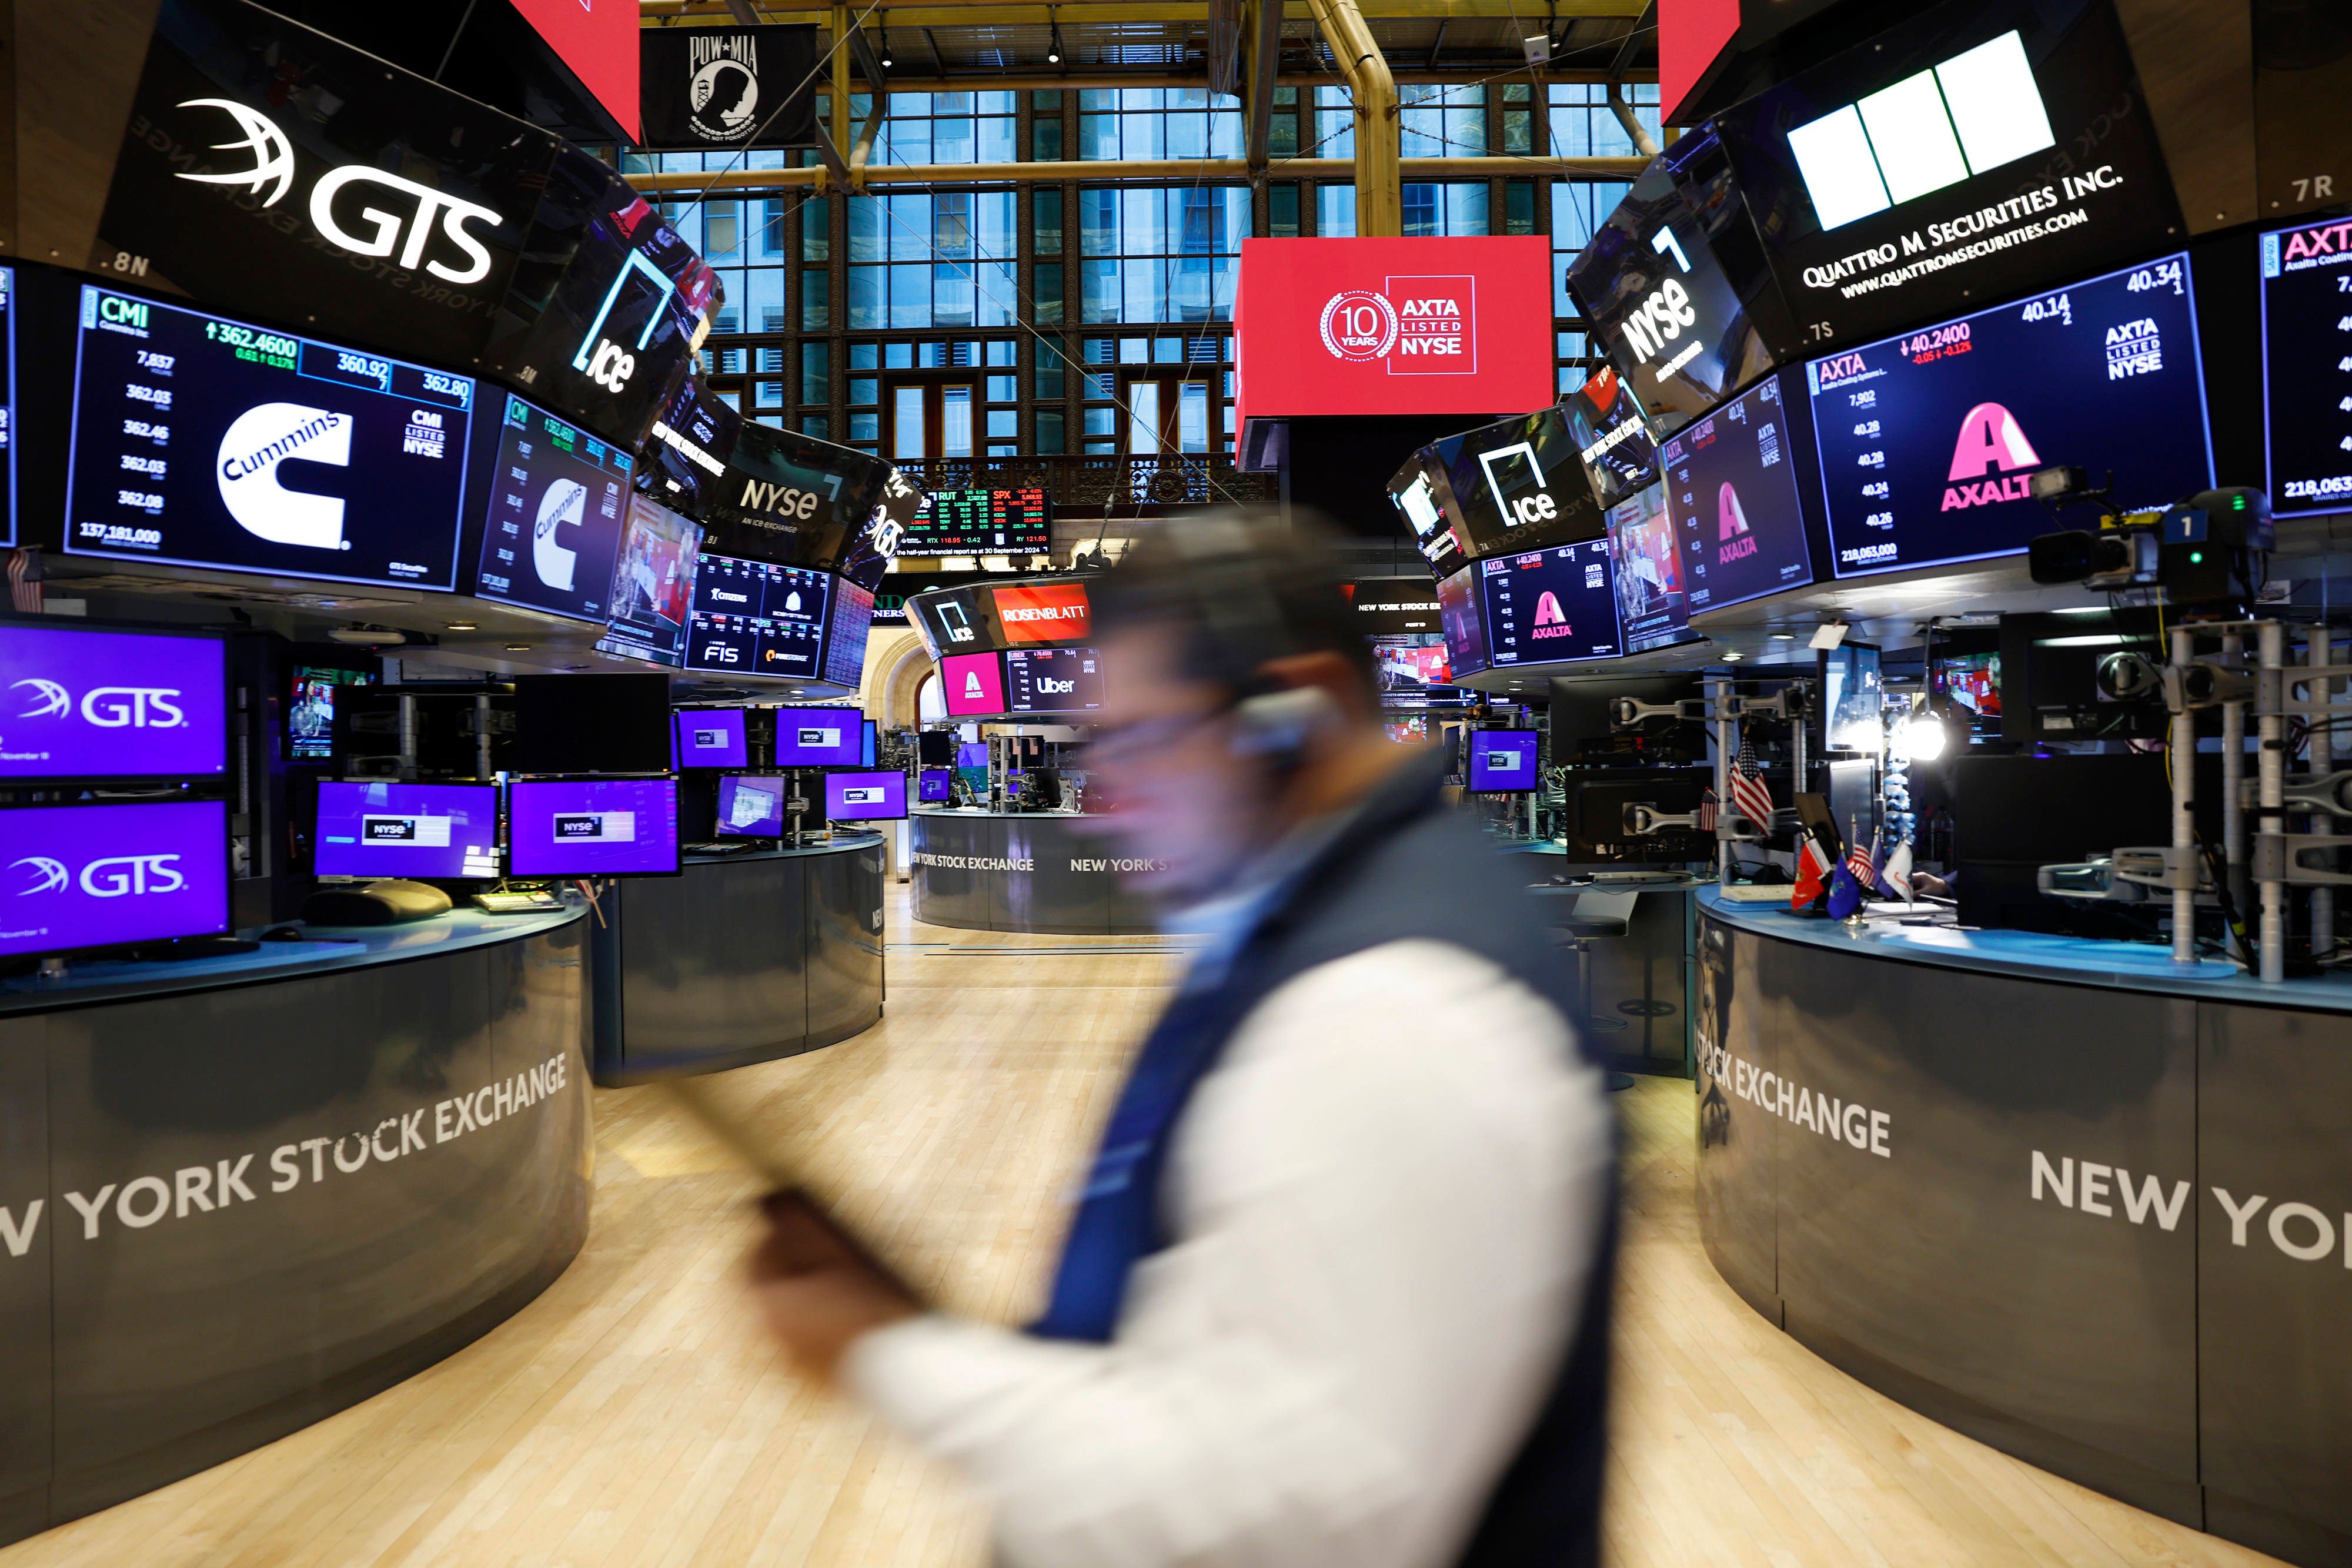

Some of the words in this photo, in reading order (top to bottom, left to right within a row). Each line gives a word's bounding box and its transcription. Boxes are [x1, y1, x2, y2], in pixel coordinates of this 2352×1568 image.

[690, 36, 723, 79] POW
[730, 35, 757, 76] MIA
[689, 123, 699, 133] YOU
[725, 123, 757, 141] FORGOTTEN
[2291, 176, 2333, 202] 7R
[309, 165, 503, 284] GTS
[1803, 243, 1897, 289] QUATTRO
[1901, 231, 1926, 256] M
[1927, 186, 2057, 246] SECURITIES
[2284, 223, 2352, 260] AXT
[113, 252, 149, 276] 8N
[2285, 259, 2318, 272] Axalta
[2126, 261, 2182, 292] 40.34
[2173, 280, 2184, 295] 1
[101, 297, 148, 327] CMI
[1402, 299, 1460, 316] AXTA
[2022, 293, 2070, 323] 40.14
[99, 320, 135, 335] Cummins
[1340, 306, 1378, 336] 10
[1402, 322, 1461, 332] LISTED
[2062, 312, 2072, 325] 2
[1810, 322, 1834, 340] 7S
[1910, 323, 1970, 353] 40.2400
[2106, 317, 2159, 345] AXTA
[218, 324, 298, 357] 362.4600
[1341, 336, 1378, 346] YEARS
[1402, 337, 1461, 355] NYSE
[2107, 339, 2160, 360] LISTED
[137, 350, 175, 369] 7,837
[1913, 351, 1935, 365] -0.05
[1943, 341, 1972, 356] -0.12%
[267, 355, 296, 370] 0.17%
[338, 353, 388, 379] 360.92
[1820, 353, 1866, 382] AXTA
[2108, 353, 2163, 380] NYSE
[379, 378, 387, 390] 7
[423, 373, 469, 397] 362.80
[1760, 382, 1778, 402] 40.34
[126, 384, 172, 404] 362.03
[460, 396, 467, 407] 7
[1849, 389, 1876, 406] 7,902
[411, 410, 442, 428] CMI
[1854, 420, 1880, 436] 40.28
[123, 420, 169, 440] 362.46
[405, 426, 445, 442] LISTED
[1758, 423, 1776, 441] AXTA
[223, 411, 339, 481] Cummins
[403, 440, 445, 458] NYSE
[1759, 437, 1778, 452] LISTED
[121, 455, 167, 474] 362.03
[1761, 450, 1780, 468] NYSE
[1857, 451, 1885, 466] 40.28
[938, 492, 957, 500] RUT
[993, 490, 1011, 499] SPX
[1862, 481, 1889, 496] 40.24
[1940, 473, 2033, 512] AXALT
[118, 490, 164, 509] 362.08
[536, 484, 583, 539] Cummins
[1866, 512, 1893, 526] 40.26
[2181, 517, 2191, 536] 1
[1481, 542, 1491, 551] 7A
[1719, 535, 1758, 565] AXALTA
[1841, 543, 1897, 561] 218,063,000
[1487, 560, 1505, 571] AXTA
[1585, 564, 1602, 573] AXTA
[1586, 579, 1604, 589] NYSE
[1003, 606, 1085, 621] ROSENBLATT
[1532, 625, 1572, 640] AXALTA
[704, 646, 739, 663] FIS
[1037, 677, 1074, 694] Uber
[81, 687, 183, 728] GTS
[920, 854, 937, 867] YORK
[937, 855, 966, 869] STOCK
[968, 857, 1034, 871] EXCHANGE
[1071, 858, 1107, 872] NEW
[1110, 858, 1154, 871] YORK
[79, 854, 183, 898] GTS
[1736, 1058, 1890, 1158] EXCHANGE
[64, 1153, 257, 1240] YORK
[269, 1108, 427, 1193] STOCK
[435, 1052, 567, 1145] EXCHANGE
[2031, 1150, 2191, 1232] NEW
[2212, 1186, 2352, 1270] YO
